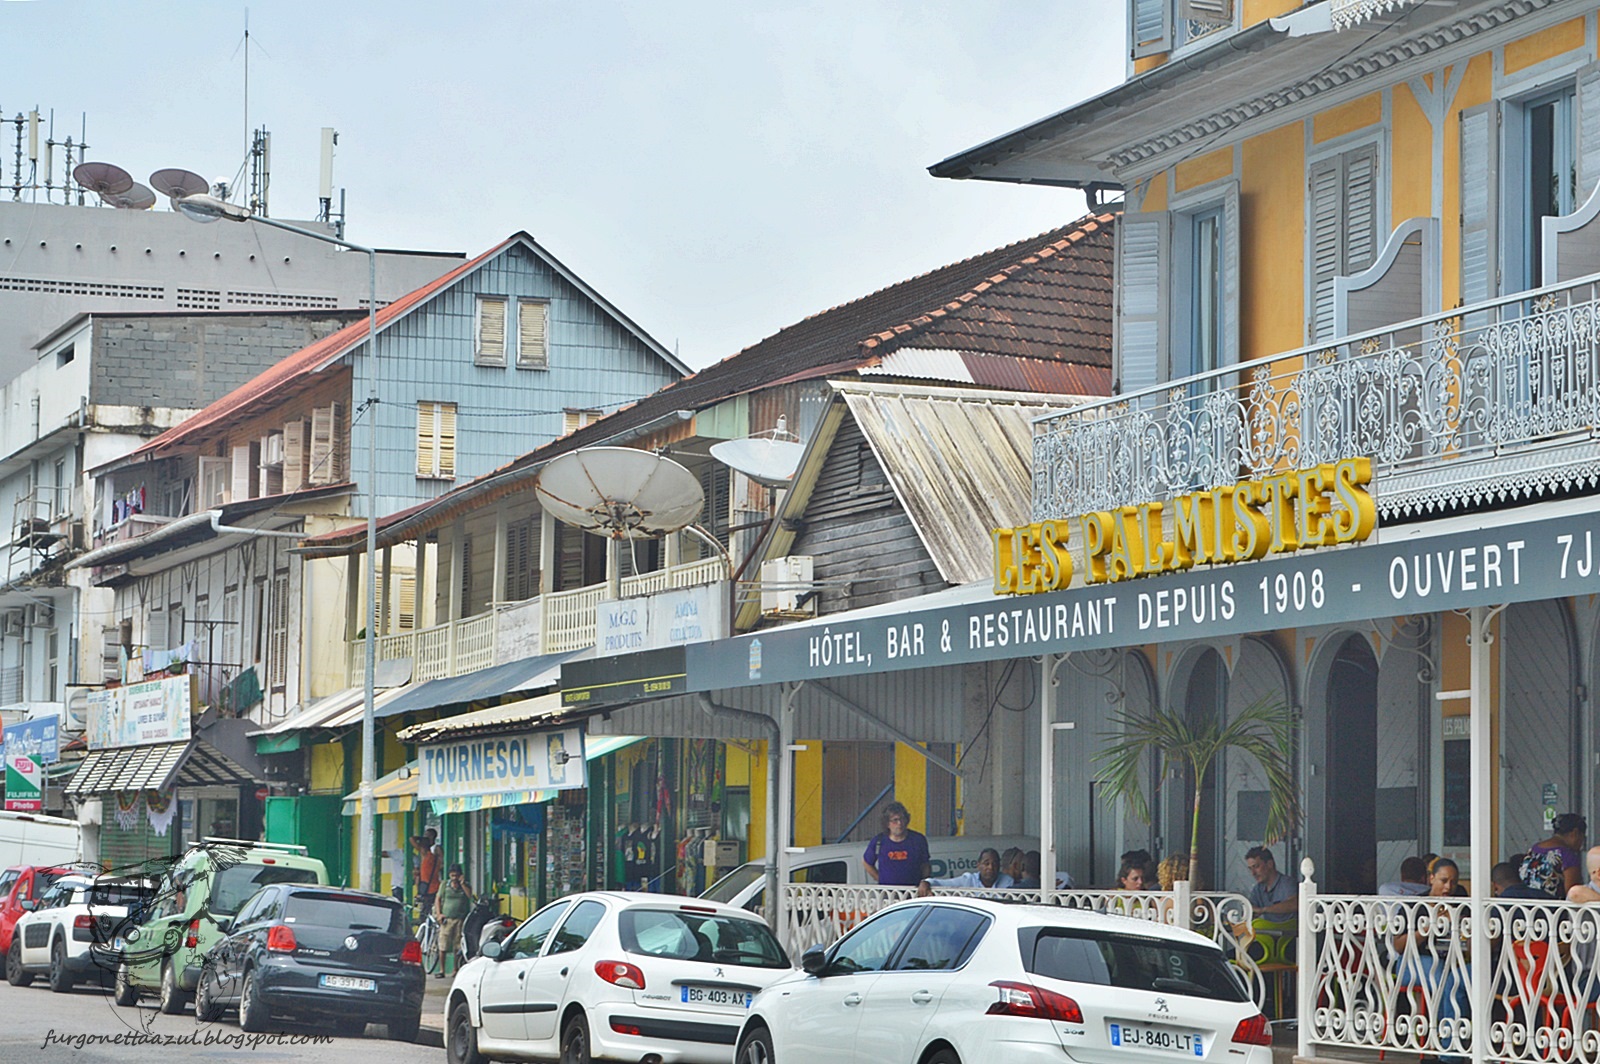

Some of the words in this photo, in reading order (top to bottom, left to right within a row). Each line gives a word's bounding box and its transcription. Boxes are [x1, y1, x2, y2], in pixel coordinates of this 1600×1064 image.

[991, 520, 1073, 596] LES
[1081, 457, 1375, 584] PALMISTES
[809, 627, 873, 668] HÔTEL,
[887, 622, 925, 659] BAR
[940, 624, 953, 653] &
[969, 597, 1118, 650] RESTAURANT
[1138, 580, 1236, 630] DEPUIS
[1259, 567, 1326, 614] 1908
[1388, 540, 1526, 600] OUVERT
[1556, 530, 1600, 580] 7J
[604, 631, 642, 651] PRODUITS
[425, 738, 535, 785] TOURNESOL
[12, 801, 35, 809] Photo
[948, 858, 978, 870] hôte
